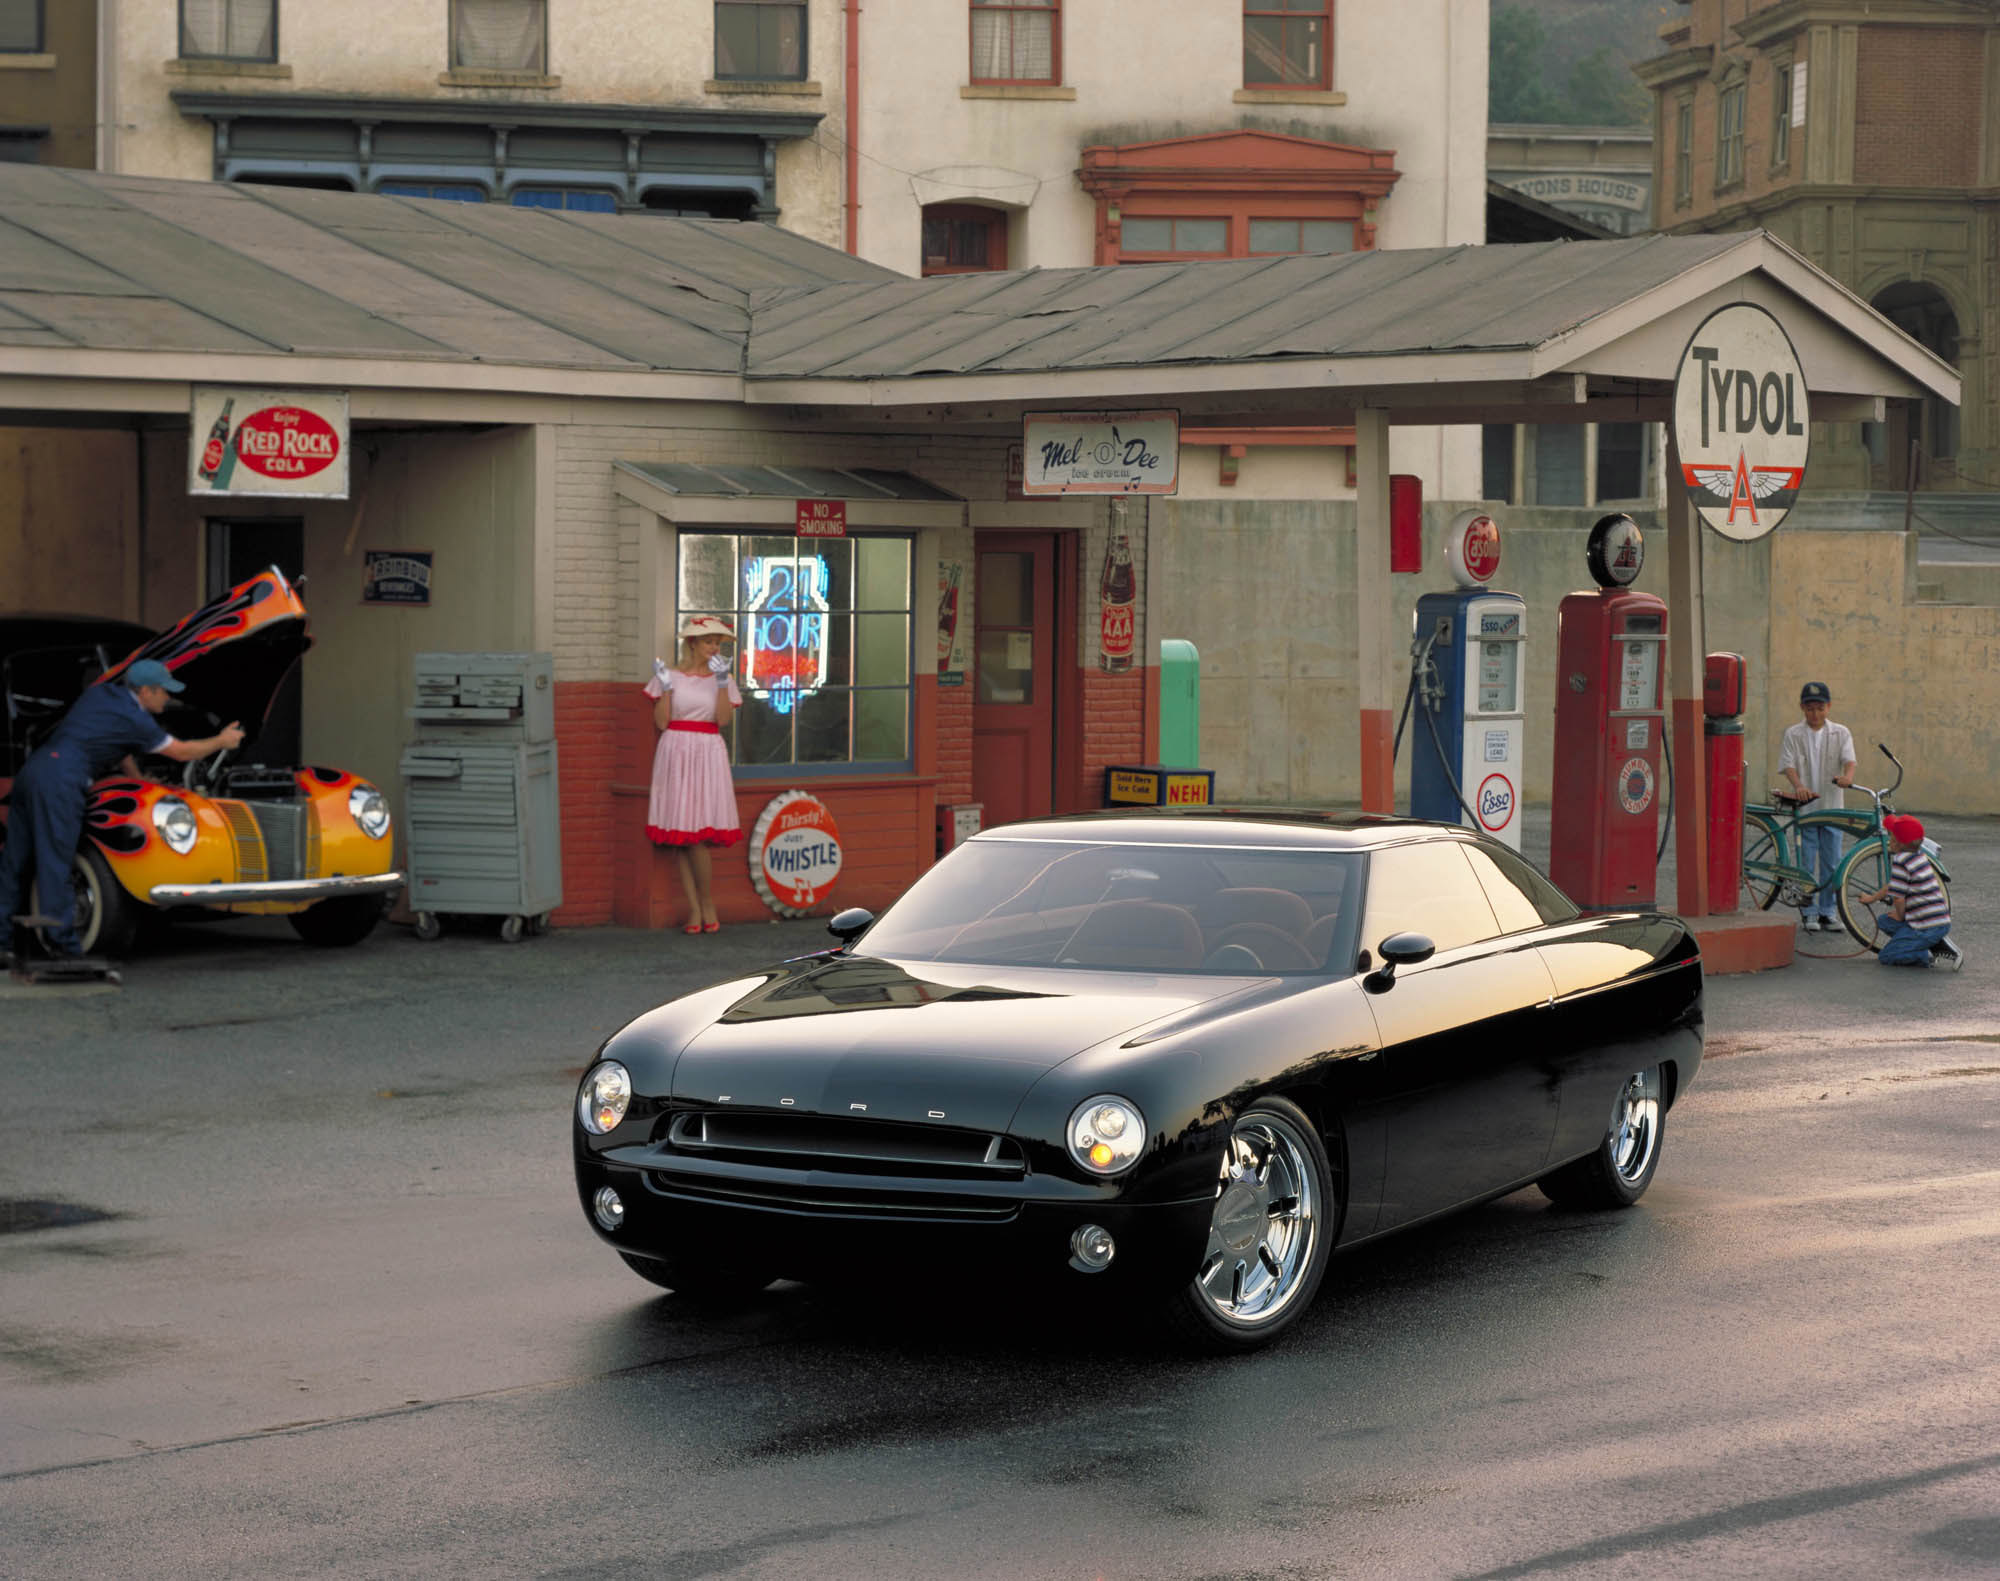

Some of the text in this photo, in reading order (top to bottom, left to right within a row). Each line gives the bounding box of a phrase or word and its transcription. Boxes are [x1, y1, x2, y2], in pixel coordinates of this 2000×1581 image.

[1513, 178, 1638, 201] YONS HOUSE
[1692, 346, 1803, 448] TYDOL
[241, 427, 281, 455] RED
[283, 429, 333, 458] ROCK
[265, 458, 306, 473] COLA
[1093, 469, 1131, 478] cream
[813, 503, 829, 518] NO
[800, 519, 844, 535] SMOKING
[754, 614, 822, 651] HOUR
[1103, 618, 1132, 638] AAA
[1169, 784, 1208, 804] NEHI
[1482, 789, 1510, 816] Esso
[781, 810, 825, 829] Thirsty!
[769, 842, 837, 873] WHISTLE
[718, 1095, 945, 1119] FORD
